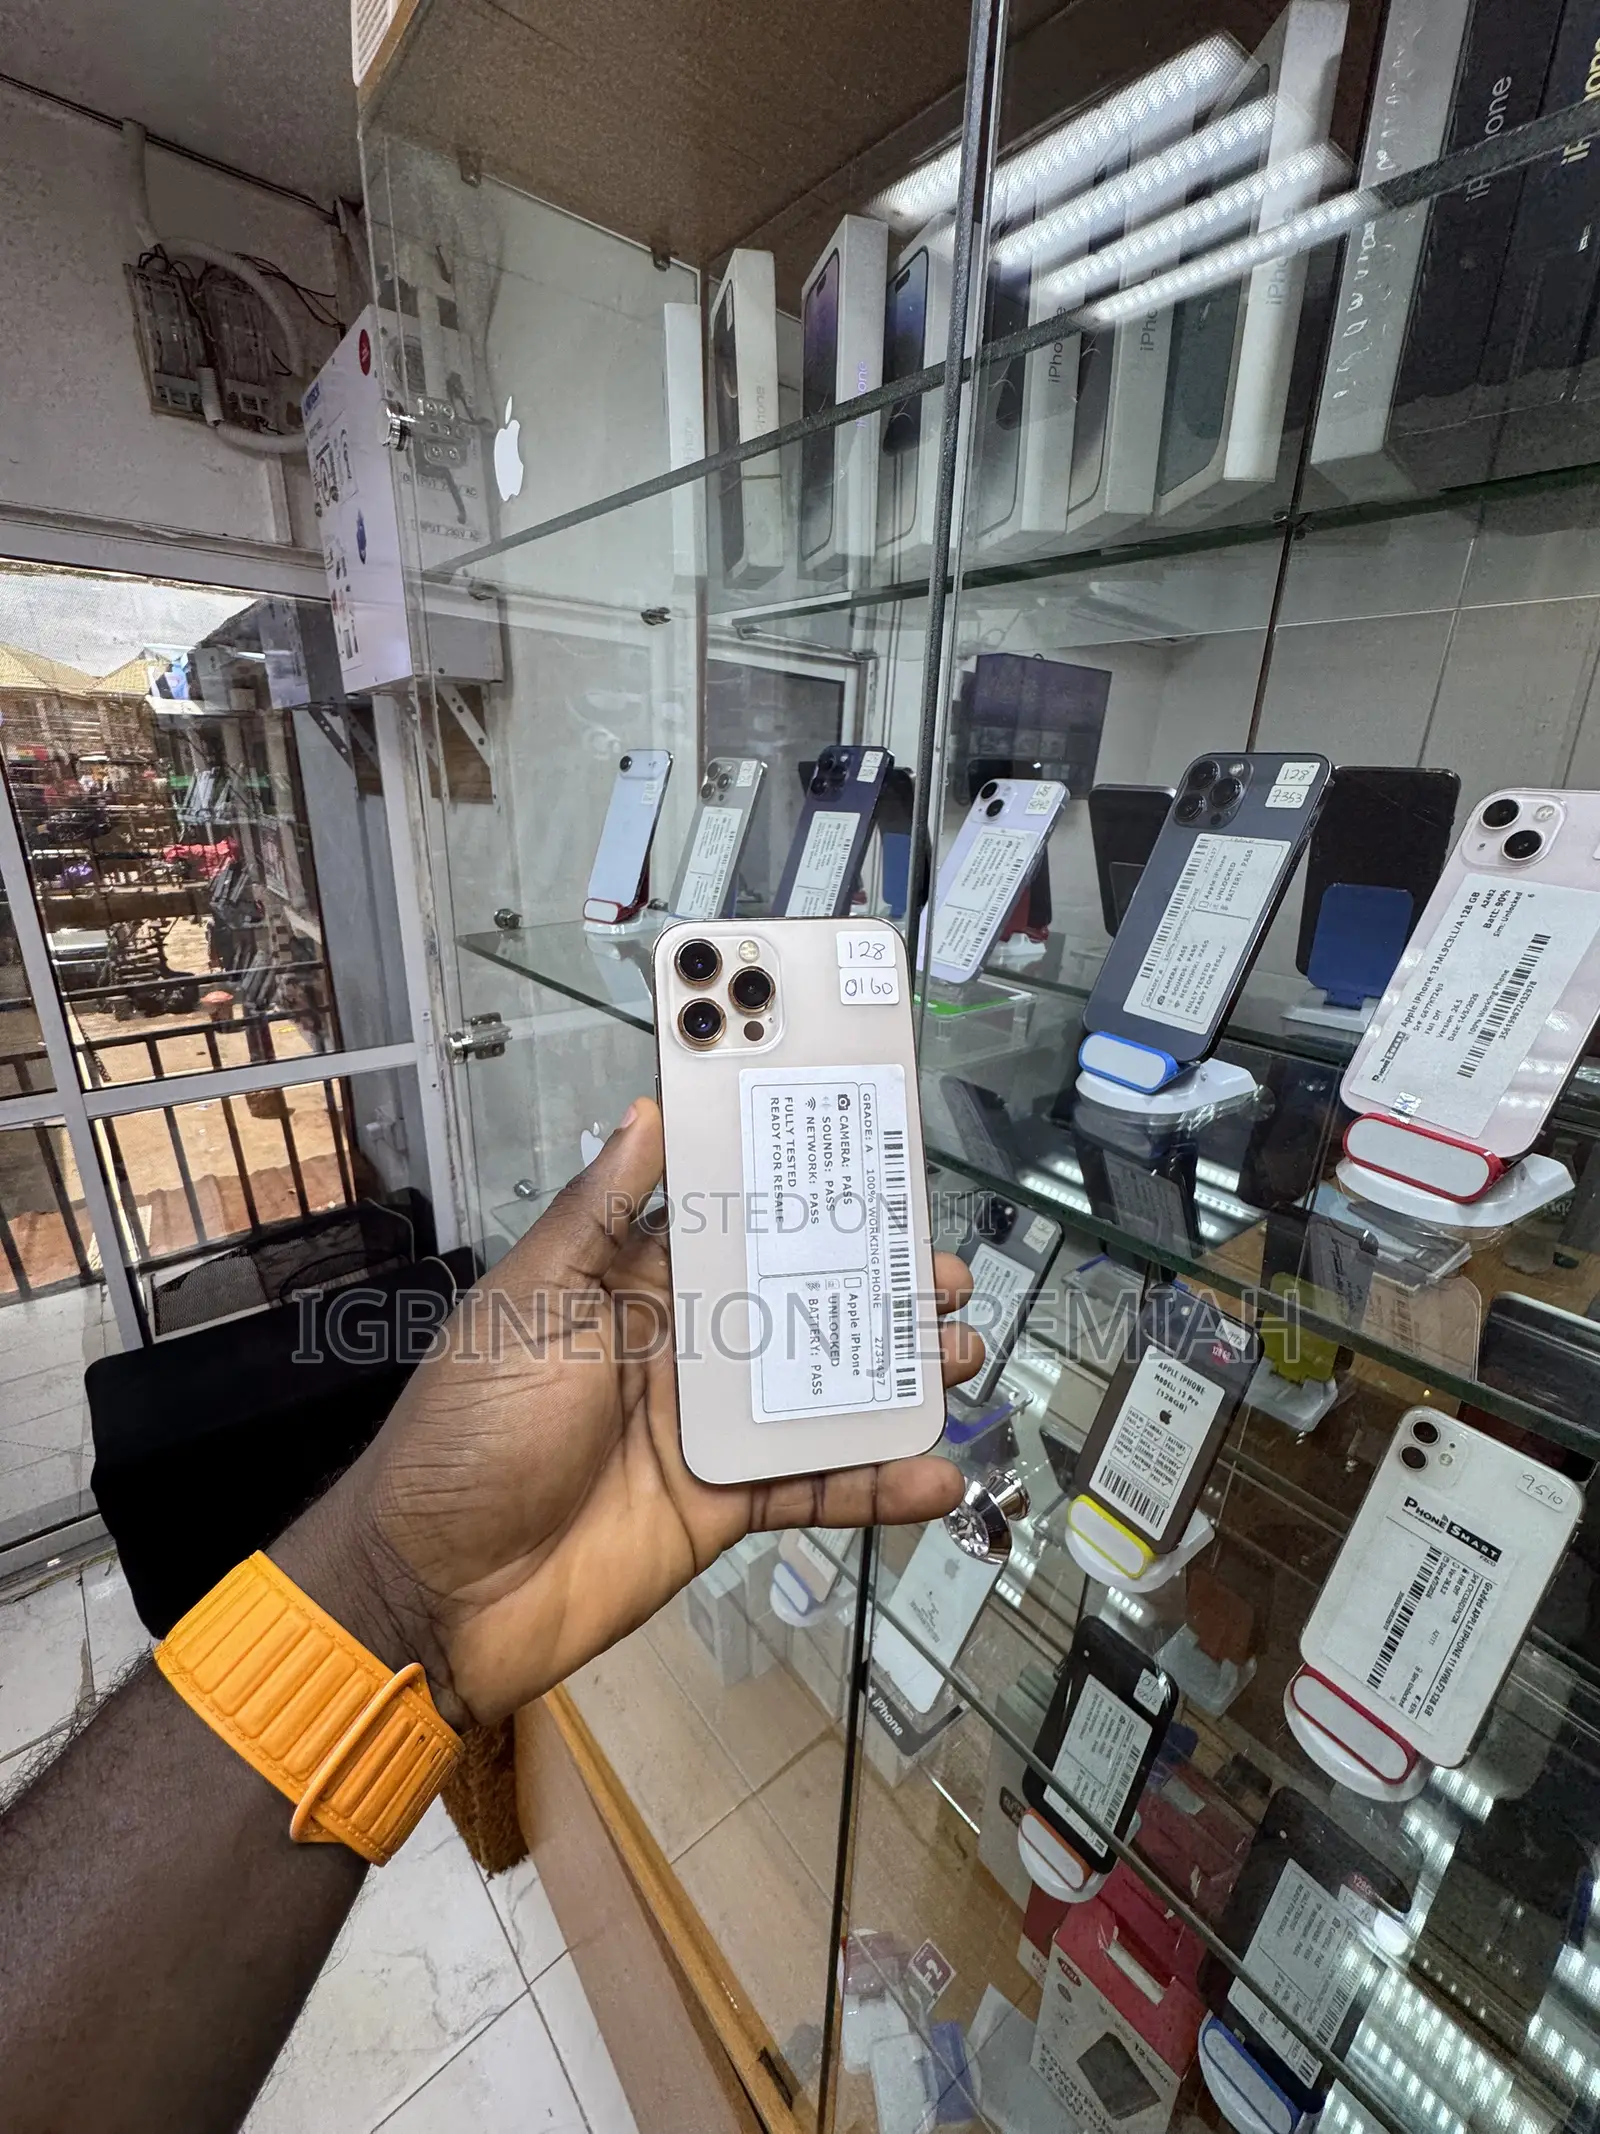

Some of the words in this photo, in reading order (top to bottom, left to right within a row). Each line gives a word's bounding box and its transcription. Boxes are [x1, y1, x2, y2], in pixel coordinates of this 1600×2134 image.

[1561, 38, 1600, 166] iPone
[1465, 75, 1512, 204] iPone
[1265, 207, 1297, 306] iPhoe
[1139, 267, 1161, 350] iPhoe
[1048, 306, 1066, 384] iPhoe
[1482, 906, 1500, 930] Batt:
[1494, 886, 1511, 908] 90%
[1500, 890, 1523, 923] Unlocked
[846, 940, 887, 961] 128
[1399, 1003, 1419, 1029] Apple
[1428, 964, 1440, 976] 13
[1459, 902, 1473, 920] 128
[1468, 890, 1480, 904] GB
[1477, 988, 1498, 1019] Working
[1492, 967, 1509, 991] Phone
[768, 1097, 781, 1140] READY
[782, 1096, 794, 1135] FULLY
[861, 1093, 873, 1141] GRADE:
[772, 1143, 782, 1171] FOR
[804, 1116, 818, 1184] NETWORK:
[820, 1116, 833, 1171] SOUNDS:
[837, 1115, 851, 1167] CAMERA:
[865, 1144, 873, 1153] A
[785, 1141, 797, 1187] TESTED
[865, 1168, 876, 1203] 100%
[772, 1174, 785, 1223] RESALE
[808, 1192, 819, 1224] PASS
[823, 1180, 835, 1212] PASS
[841, 1175, 852, 1205] PASS
[867, 1207, 880, 1264] WORKING
[870, 1268, 882, 1308] PHONE
[806, 1298, 821, 1356] BATTERY:
[825, 1295, 840, 1367] UNLOCKED
[846, 1293, 859, 1327] Apple
[849, 1332, 862, 1376] iPhone
[1157, 1361, 1178, 1378] APPLE
[810, 1364, 822, 1395] PASS
[1474, 1581, 1494, 1609] Graded
[1463, 1607, 1481, 1631] APPLE
[1446, 1657, 1457, 1667] 11
[871, 1696, 904, 1736] iPhone
[1423, 1703, 1434, 1716] GB
